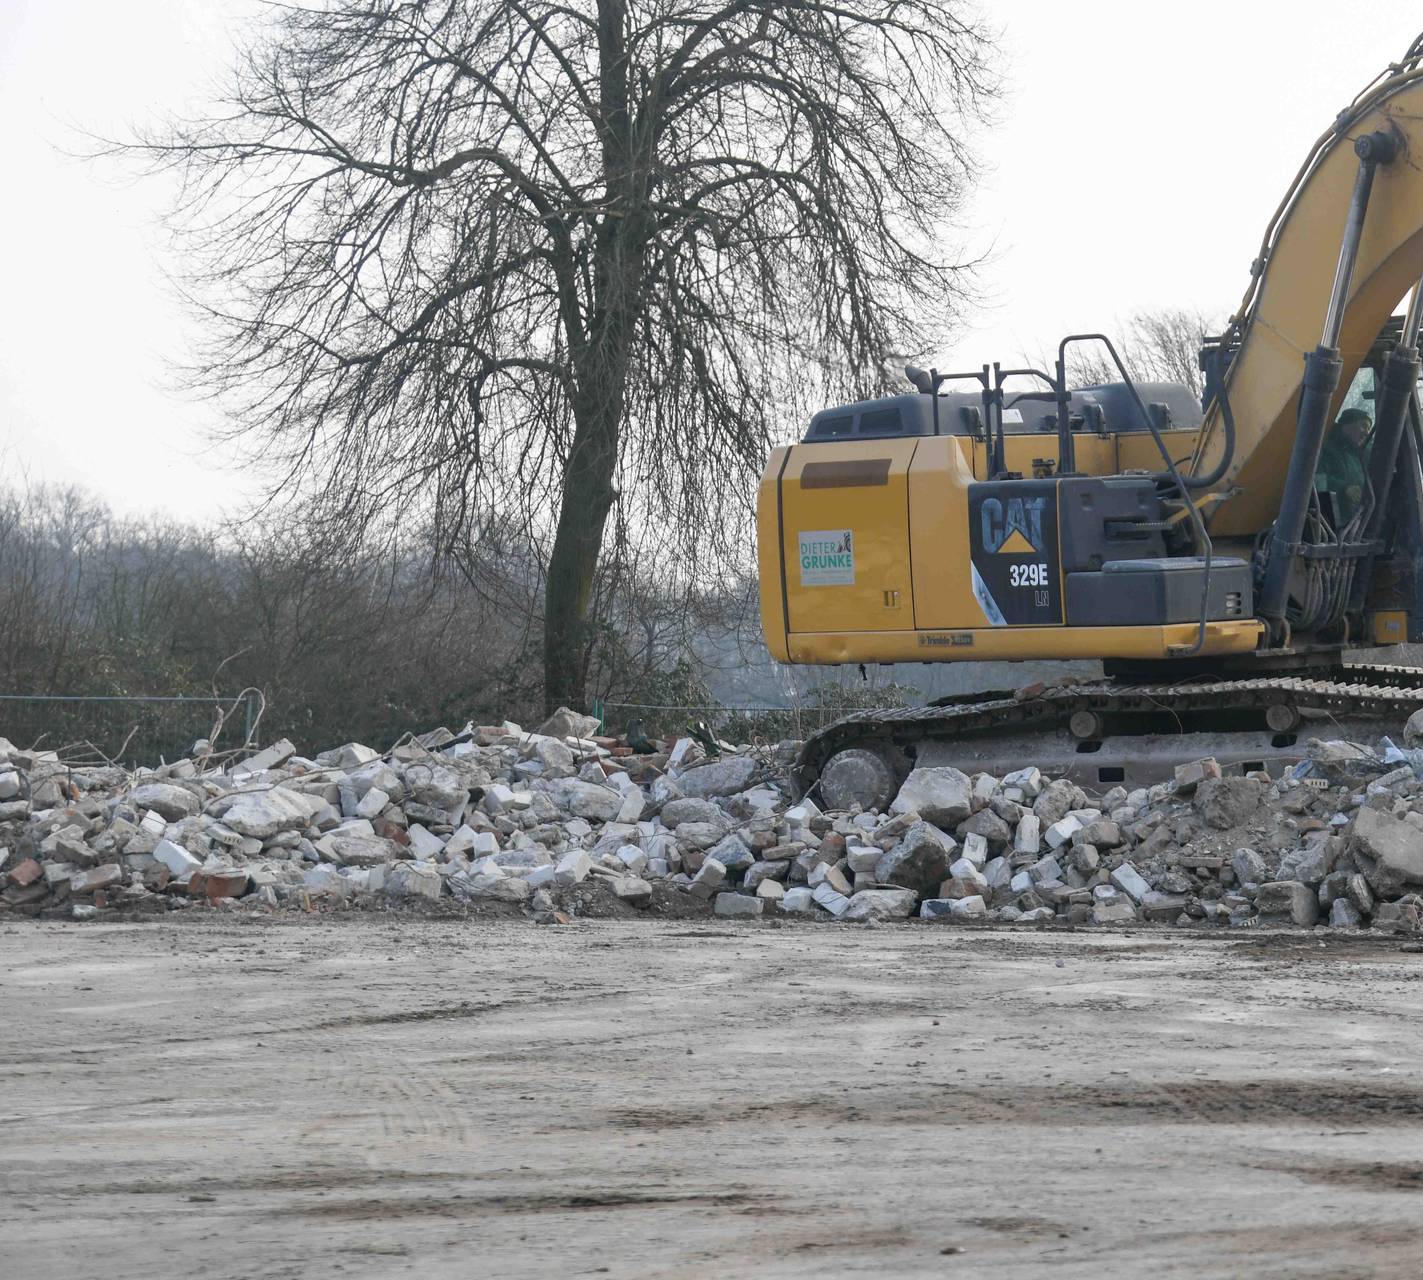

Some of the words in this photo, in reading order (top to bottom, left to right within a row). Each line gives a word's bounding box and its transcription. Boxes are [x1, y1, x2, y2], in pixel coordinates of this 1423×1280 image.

[981, 498, 1046, 554] CAT
[800, 542, 836, 555] DIETER
[801, 555, 852, 569] GRUNKE
[1009, 563, 1049, 587] 329E
